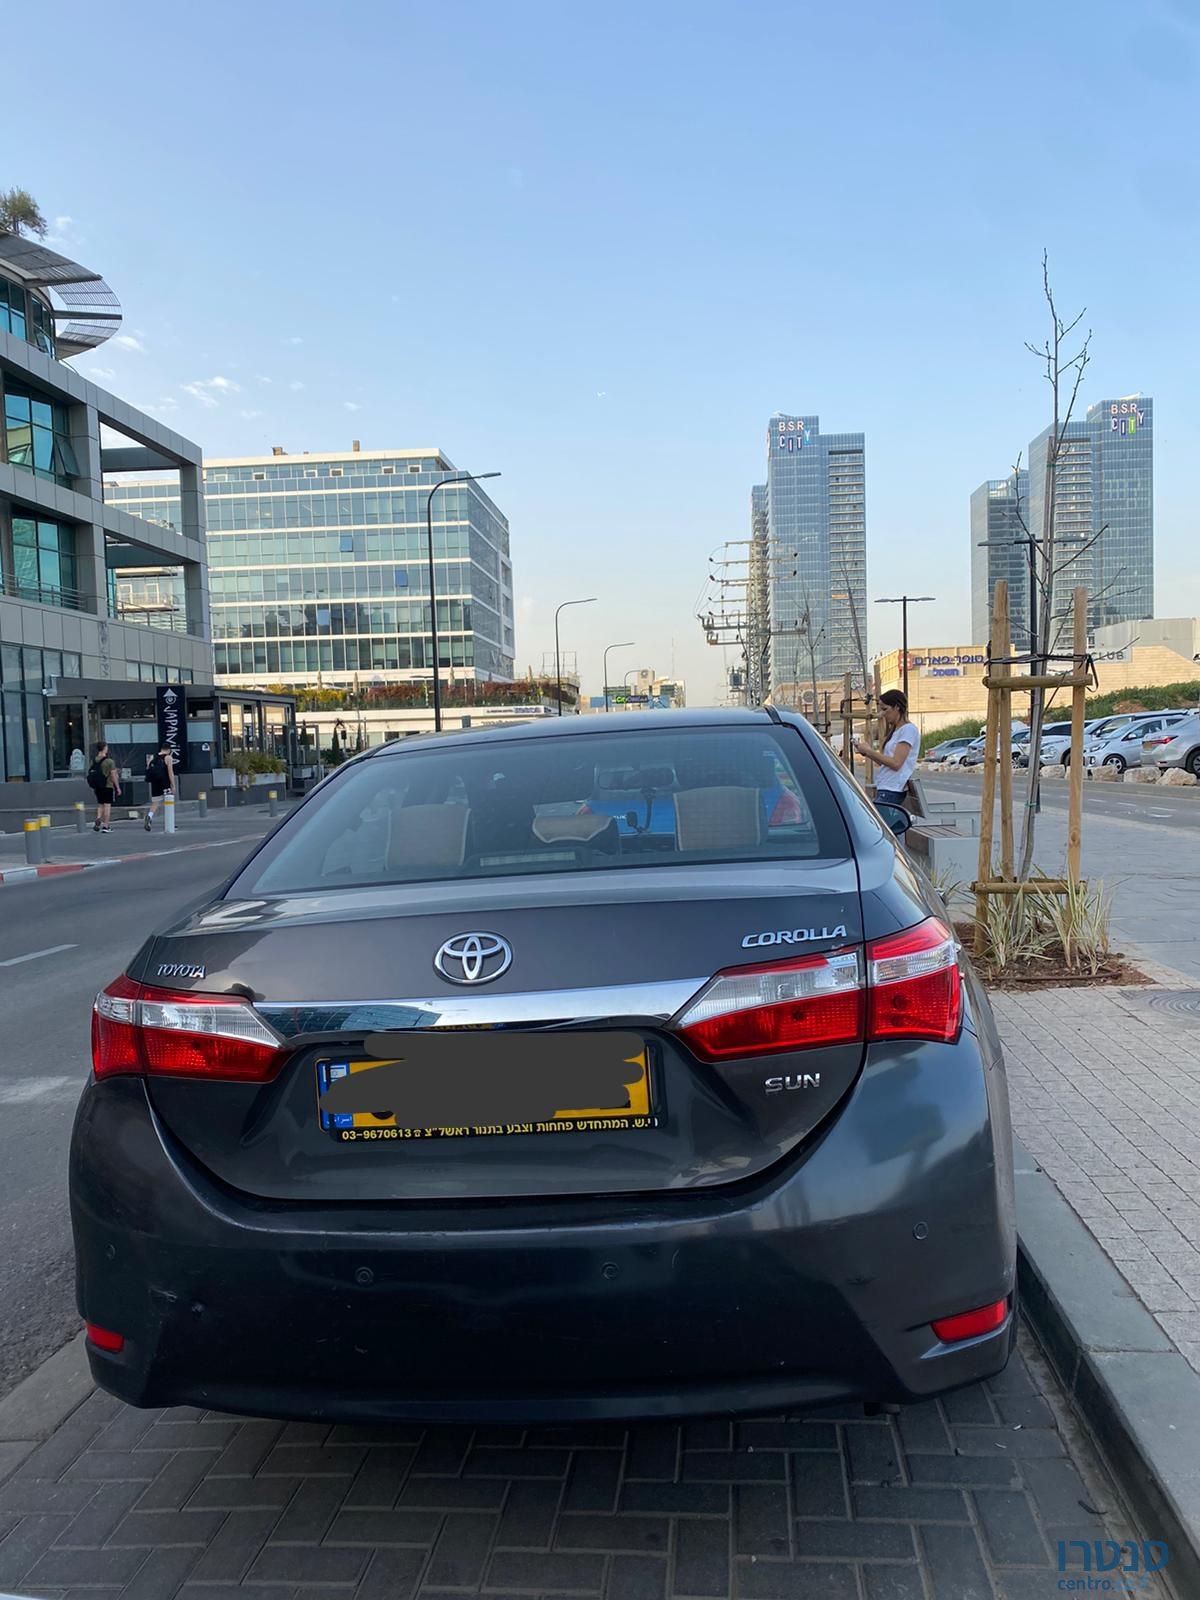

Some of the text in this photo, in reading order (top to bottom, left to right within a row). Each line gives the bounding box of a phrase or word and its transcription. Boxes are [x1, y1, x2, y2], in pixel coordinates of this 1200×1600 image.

[1111, 409, 1144, 435] CITY
[779, 429, 811, 452] CITY
[741, 925, 847, 948] COROLLA
[157, 963, 206, 978] TOYOTA
[764, 1073, 820, 1094] SUN
[506, 1123, 533, 1134] וצבע
[536, 1120, 574, 1132] פחחות
[576, 1118, 628, 1130] המתחדש
[342, 1129, 412, 1140] 03-9670613
